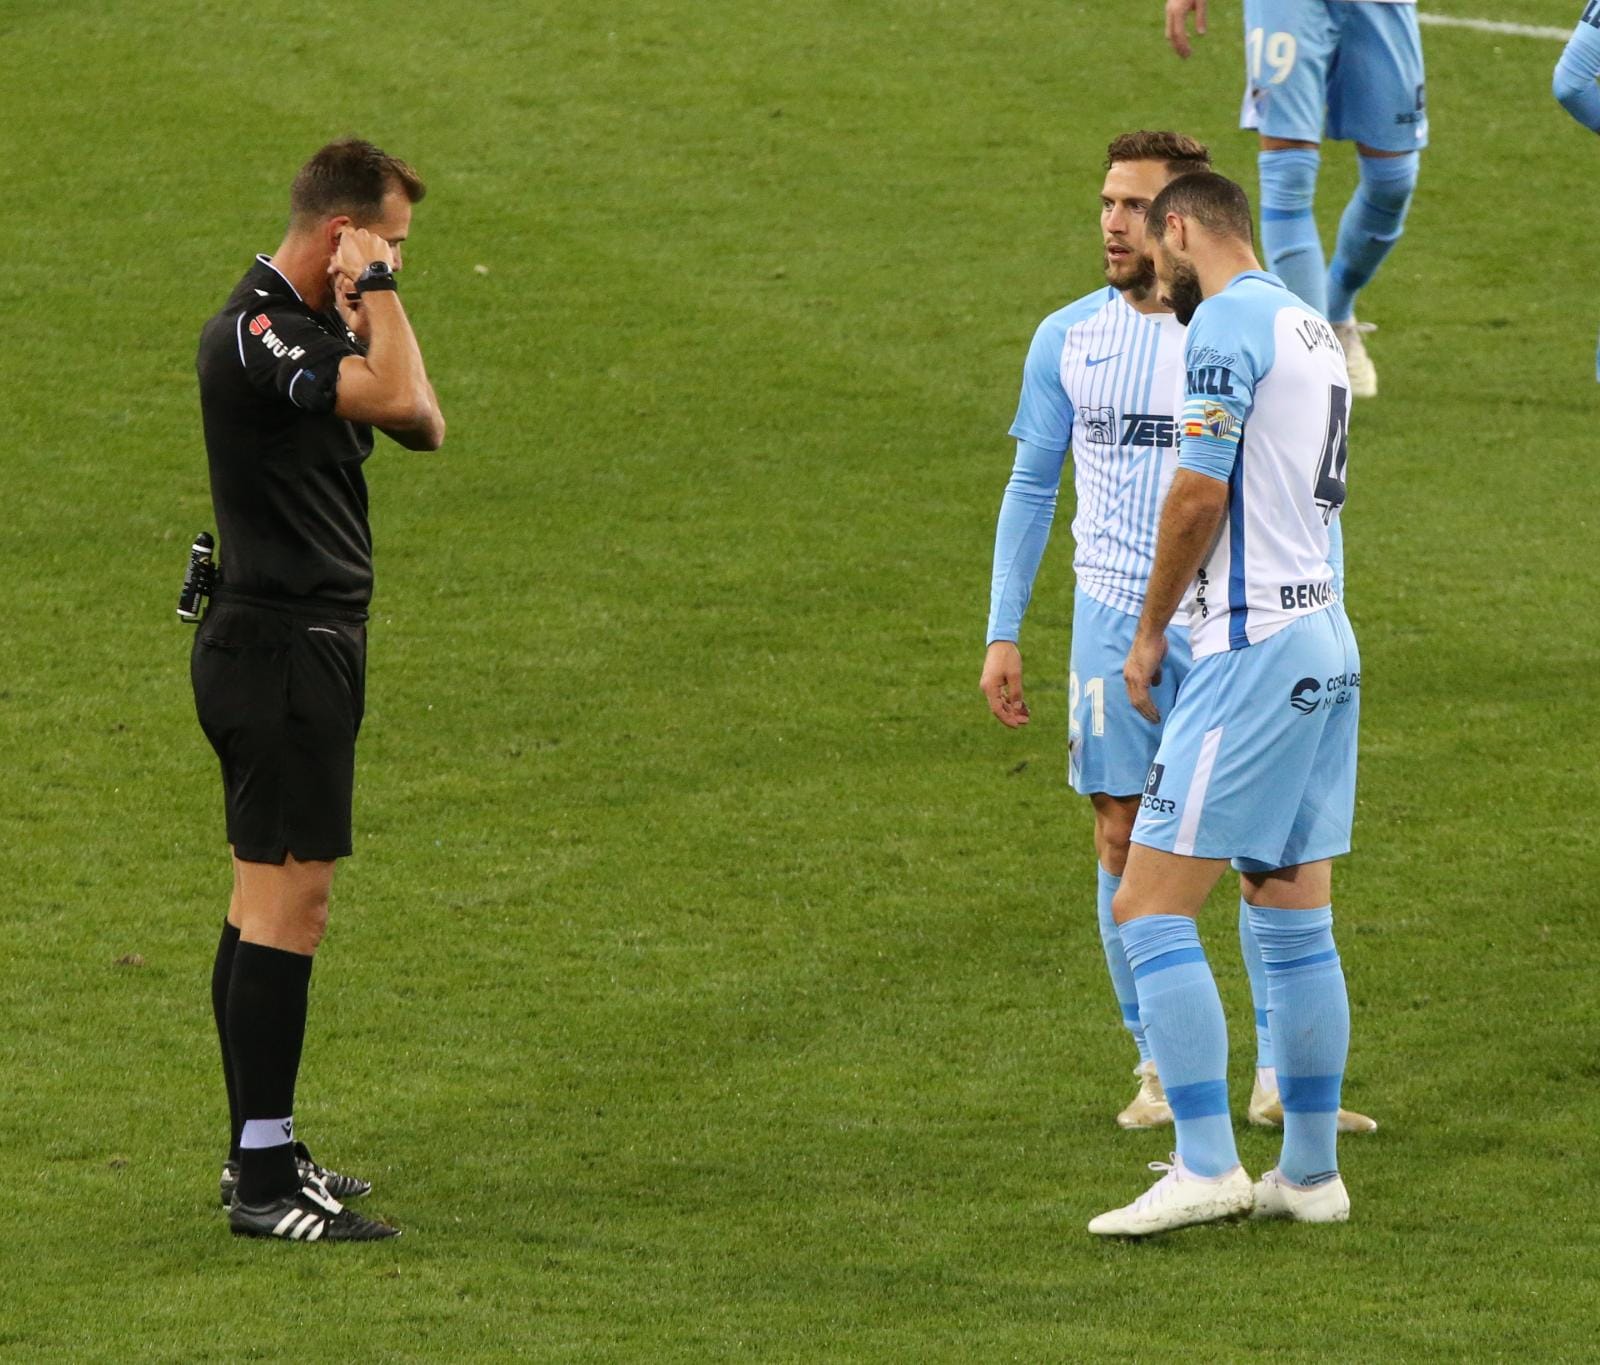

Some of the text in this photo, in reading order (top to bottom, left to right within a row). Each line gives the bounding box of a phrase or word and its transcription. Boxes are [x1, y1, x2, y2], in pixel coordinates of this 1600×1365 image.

[1246, 27, 1296, 84] 19
[1314, 384, 1347, 505] 4
[1069, 671, 1104, 737] 21
